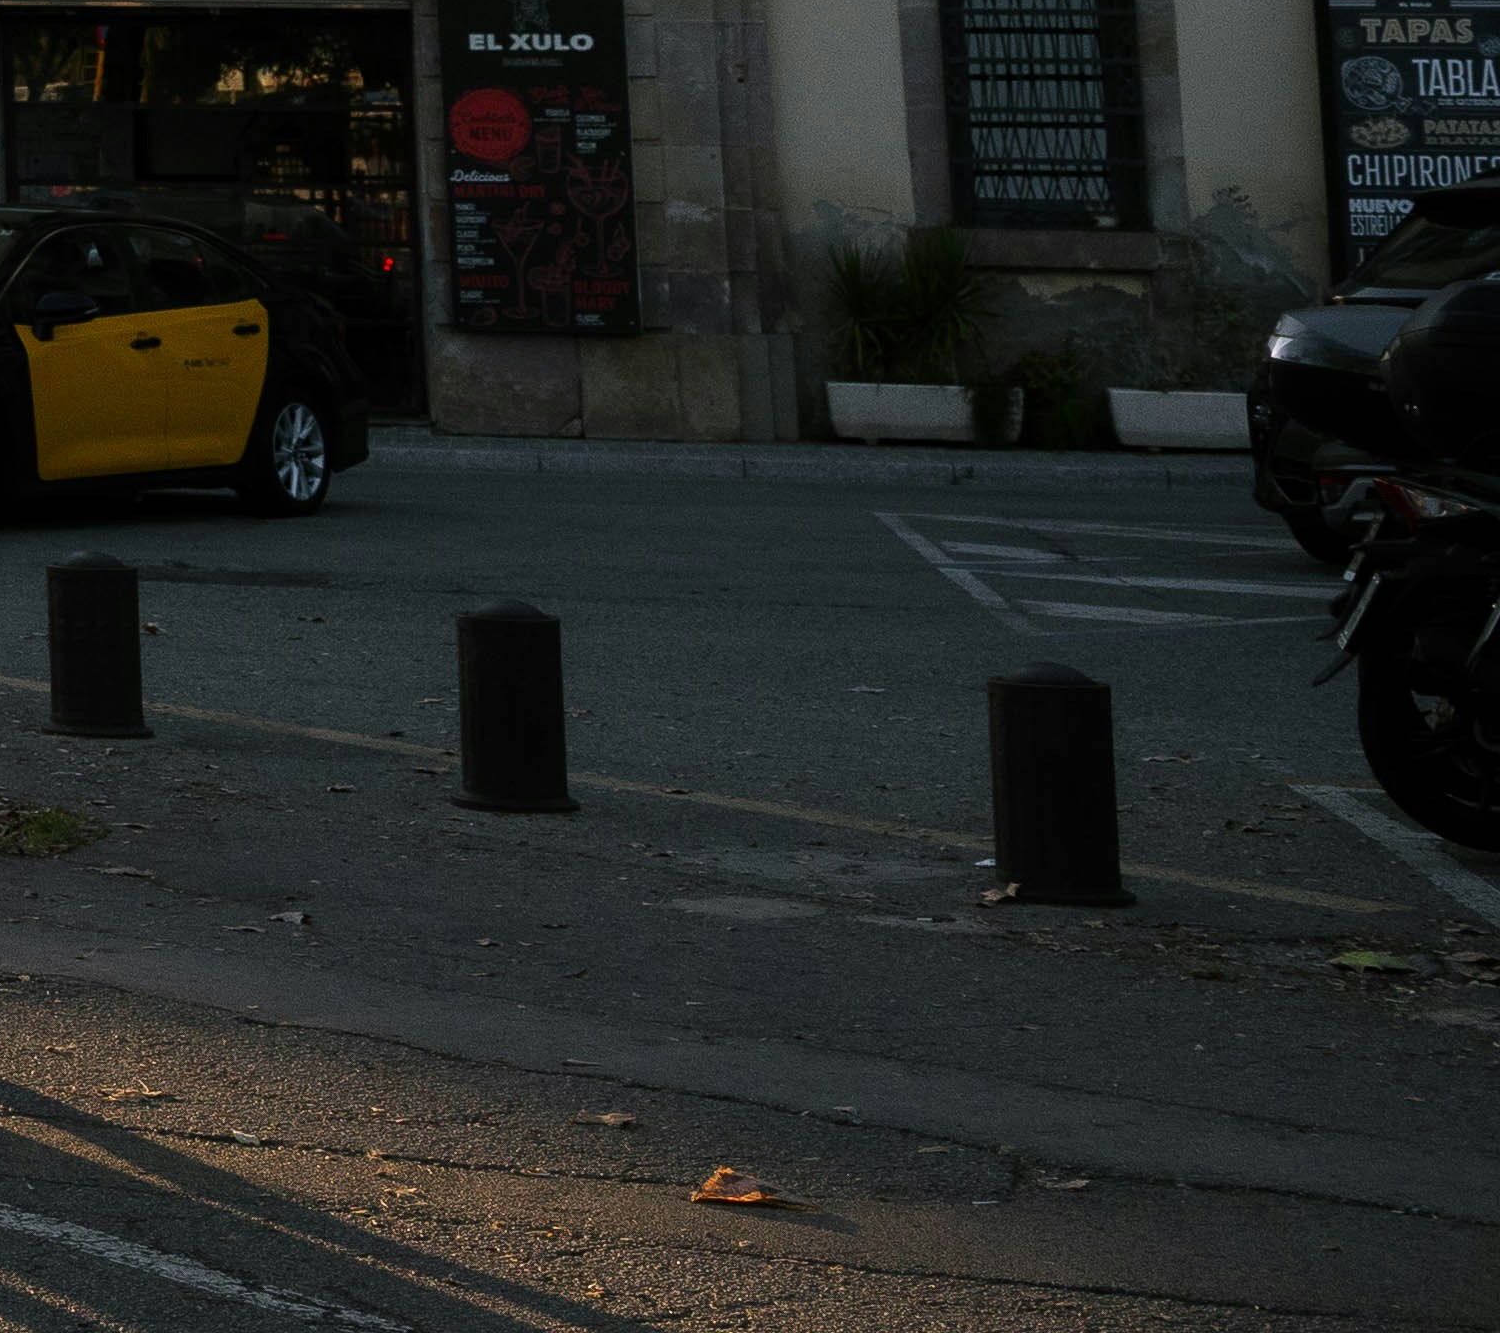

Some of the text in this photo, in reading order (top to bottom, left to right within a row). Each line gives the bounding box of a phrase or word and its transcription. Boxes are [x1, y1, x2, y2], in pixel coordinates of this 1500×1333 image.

[1360, 18, 1474, 44] TAPAS
[468, 32, 595, 52] EL XULO
[450, 169, 512, 182] Delicious
[1348, 198, 1415, 214] HUEVO
